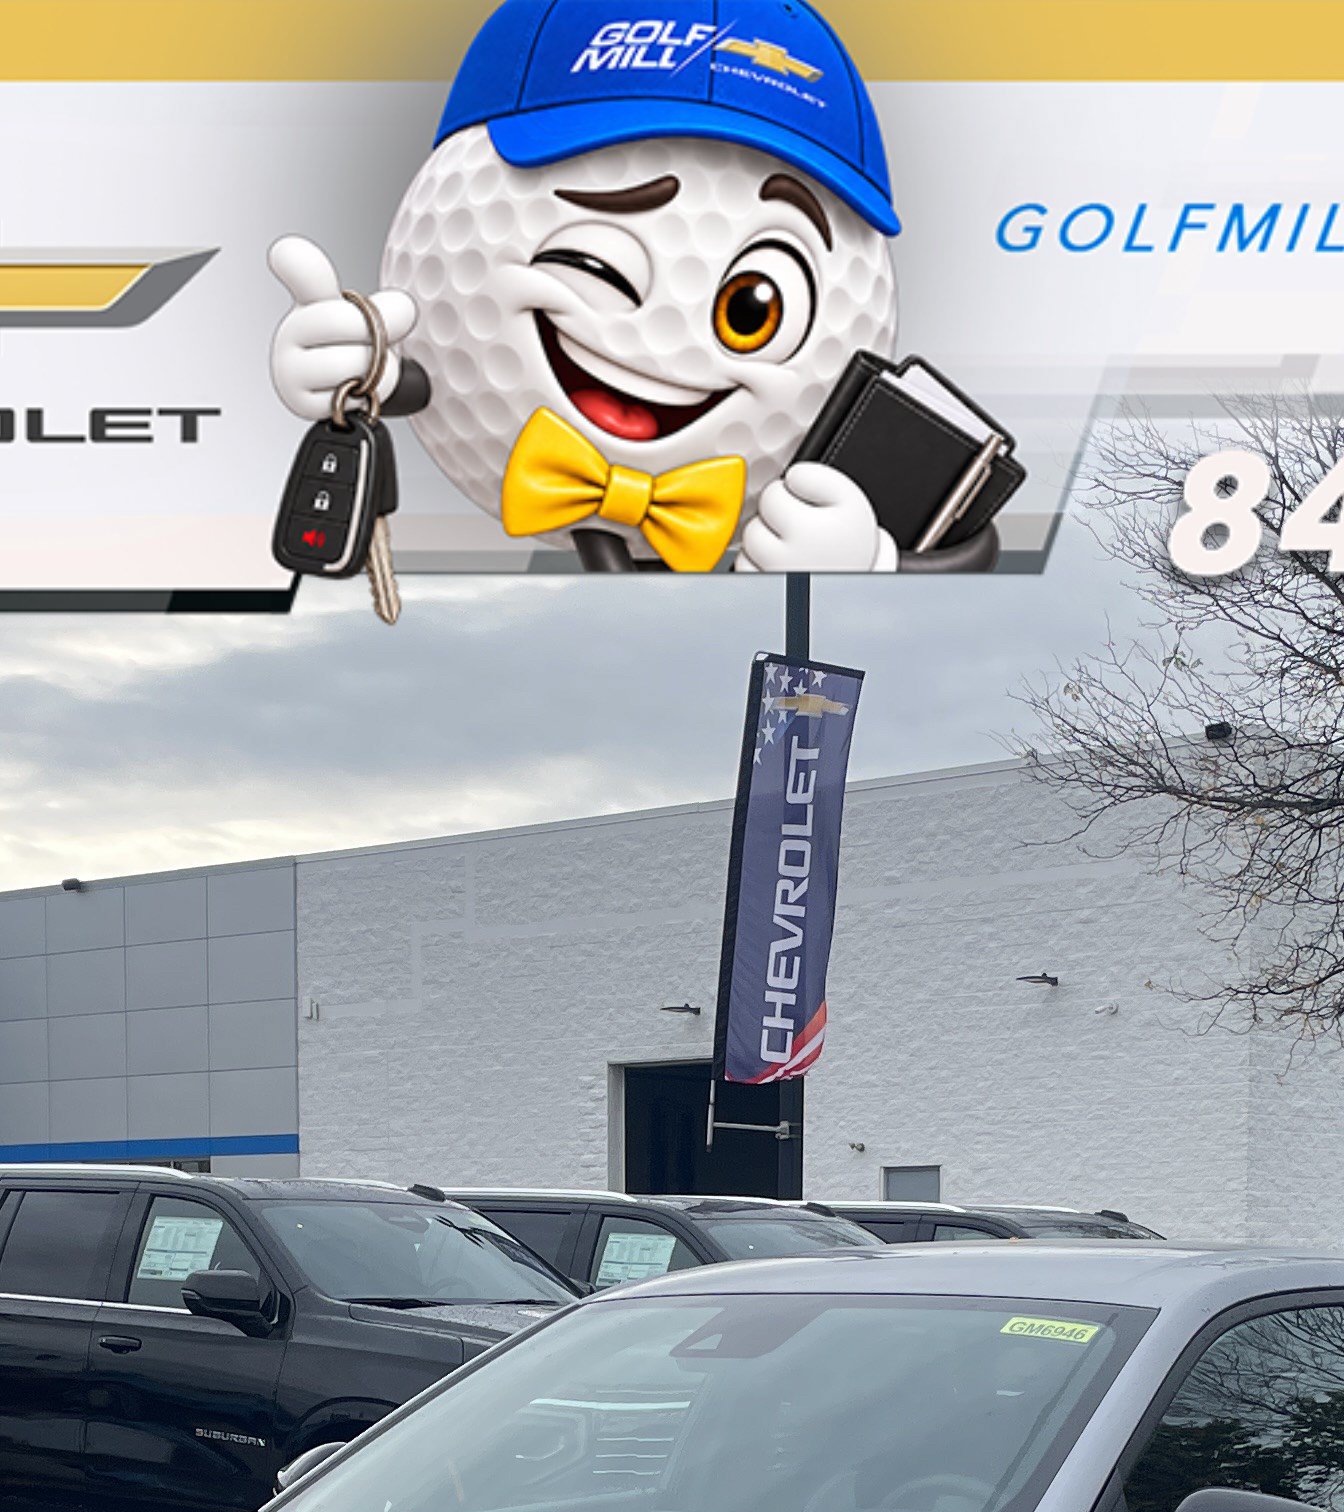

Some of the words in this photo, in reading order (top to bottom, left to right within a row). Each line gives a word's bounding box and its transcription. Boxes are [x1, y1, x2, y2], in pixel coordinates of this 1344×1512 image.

[760, 736, 820, 1064] CHEVROLET
[1009, 1320, 1088, 1340] GM6946
[195, 1427, 266, 1447] SUBURBAN
